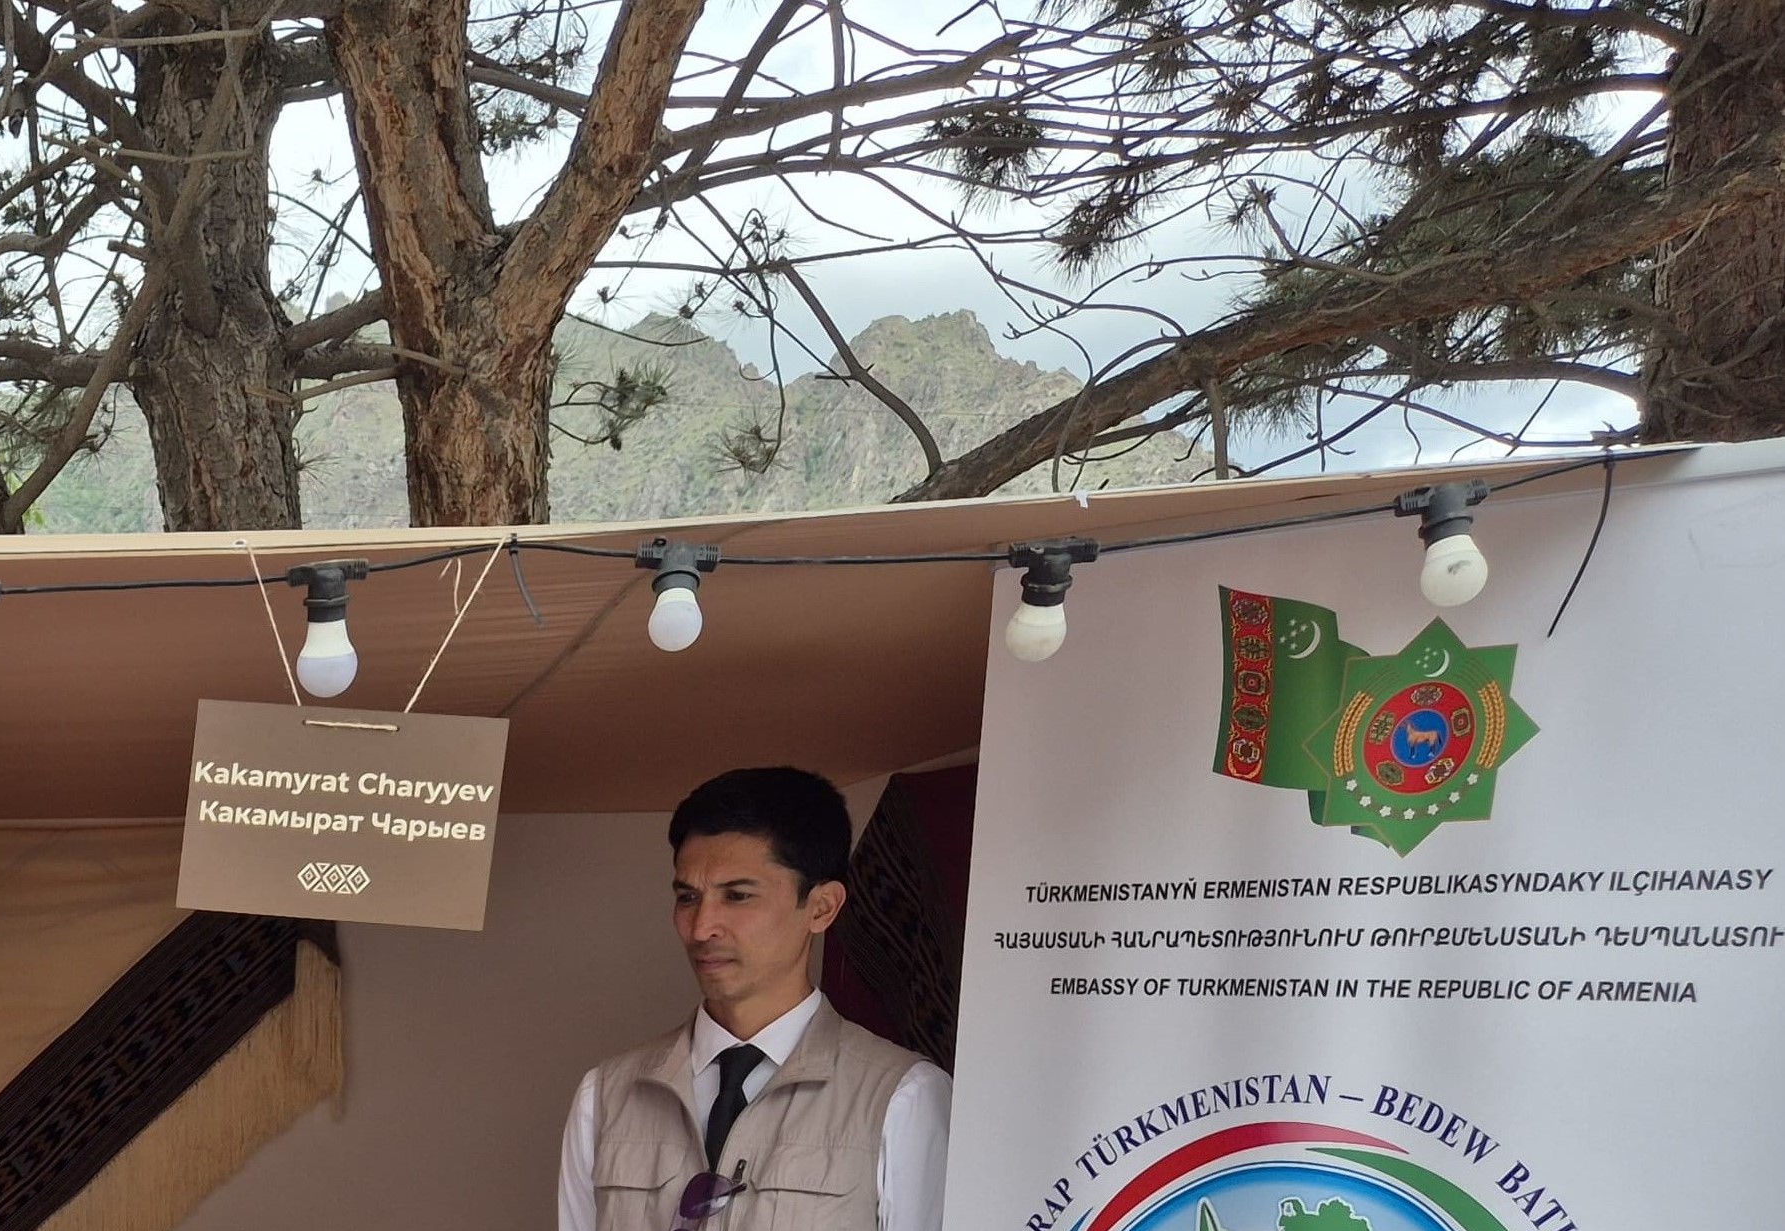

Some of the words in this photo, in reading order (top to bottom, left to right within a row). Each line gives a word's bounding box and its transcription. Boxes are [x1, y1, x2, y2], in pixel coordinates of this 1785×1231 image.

[194, 760, 350, 795] Kakamyrat
[357, 772, 494, 805] Charyyev
[199, 799, 364, 835] Какамырат
[371, 811, 486, 842] Чарыев
[1025, 877, 1198, 903] TÜRKMENISTANYŇ
[1203, 878, 1331, 900] ERMENISTAN
[1337, 870, 1605, 896] RESPUBLIKASYNDAKY
[1608, 868, 1774, 896] ILÇIHANASY
[993, 931, 1106, 949] ՀԱՅԱՍՏԱՆԻ
[1050, 977, 1140, 996] EMBASSY
[1142, 977, 1172, 996] OF
[1176, 977, 1330, 998] TURKMENISTAN
[1334, 978, 1359, 998] IN
[1365, 978, 1413, 998] THE
[1416, 979, 1531, 1000] REPUBLIC
[1536, 980, 1573, 1000] OF
[1576, 980, 1698, 1003] ARMENIA
[1074, 1073, 1333, 1181] TÜRKMENISTAN
[1369, 1083, 1501, 1166] BEDEW
